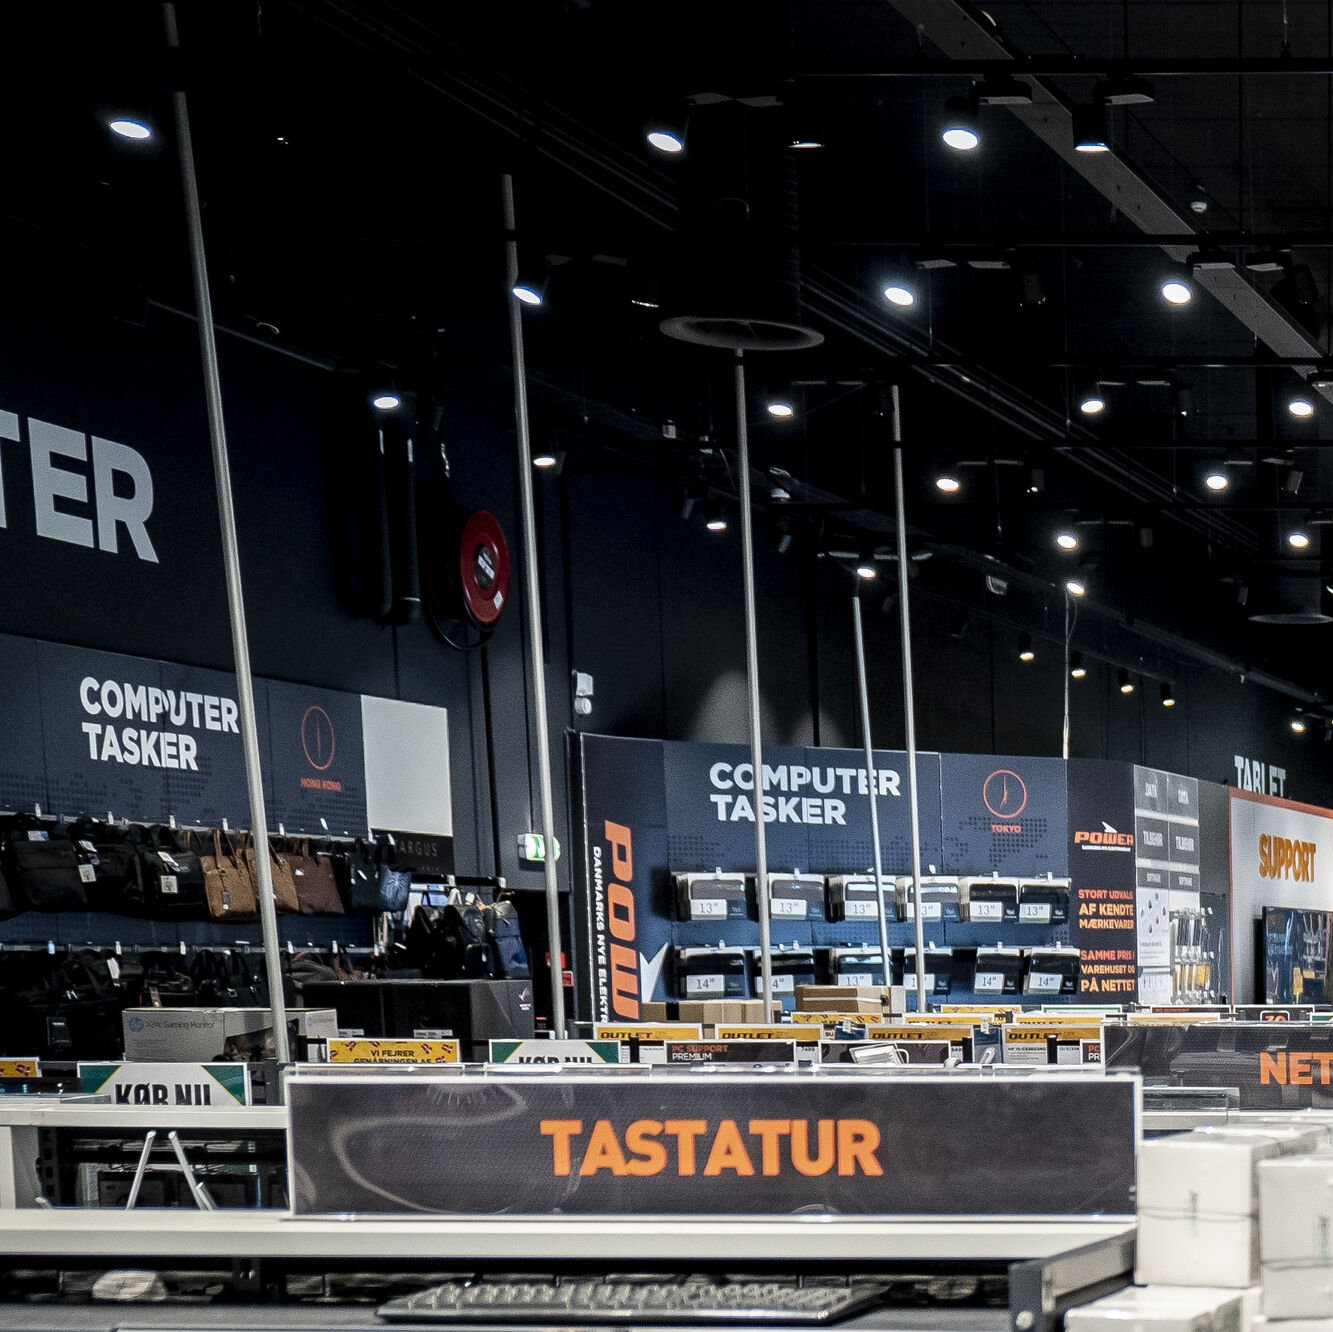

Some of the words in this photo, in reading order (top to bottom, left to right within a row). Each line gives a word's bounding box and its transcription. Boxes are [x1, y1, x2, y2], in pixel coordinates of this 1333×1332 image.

[80, 676, 240, 733] COMPUTER
[82, 722, 198, 771] TASKER
[709, 762, 901, 797] COMPUTER
[710, 794, 847, 826] TASKER
[991, 825, 1021, 834] TOKYO
[1074, 830, 1134, 846] POWER
[1258, 832, 1318, 884] SUPPORT
[592, 846, 605, 932] DANMARKS
[1078, 889, 1108, 900] STORT
[1079, 903, 1096, 915] AF
[1098, 903, 1134, 916] KENDTE
[1079, 918, 1135, 931] MÆRKEVARER
[596, 934, 606, 971] NYE
[1080, 949, 1114, 962] SAMME
[1117, 950, 1131, 962] PRIS
[1080, 964, 1125, 975] VAREHUSET
[1081, 977, 1098, 993] PÅ
[1100, 978, 1135, 992] NETTET
[371, 1049, 380, 1058] VI
[381, 1049, 415, 1058] FEJRER
[672, 1052, 712, 1061] PREMIUM
[686, 1044, 729, 1053] SUPPORT
[540, 1118, 885, 1177] TASTATUR
